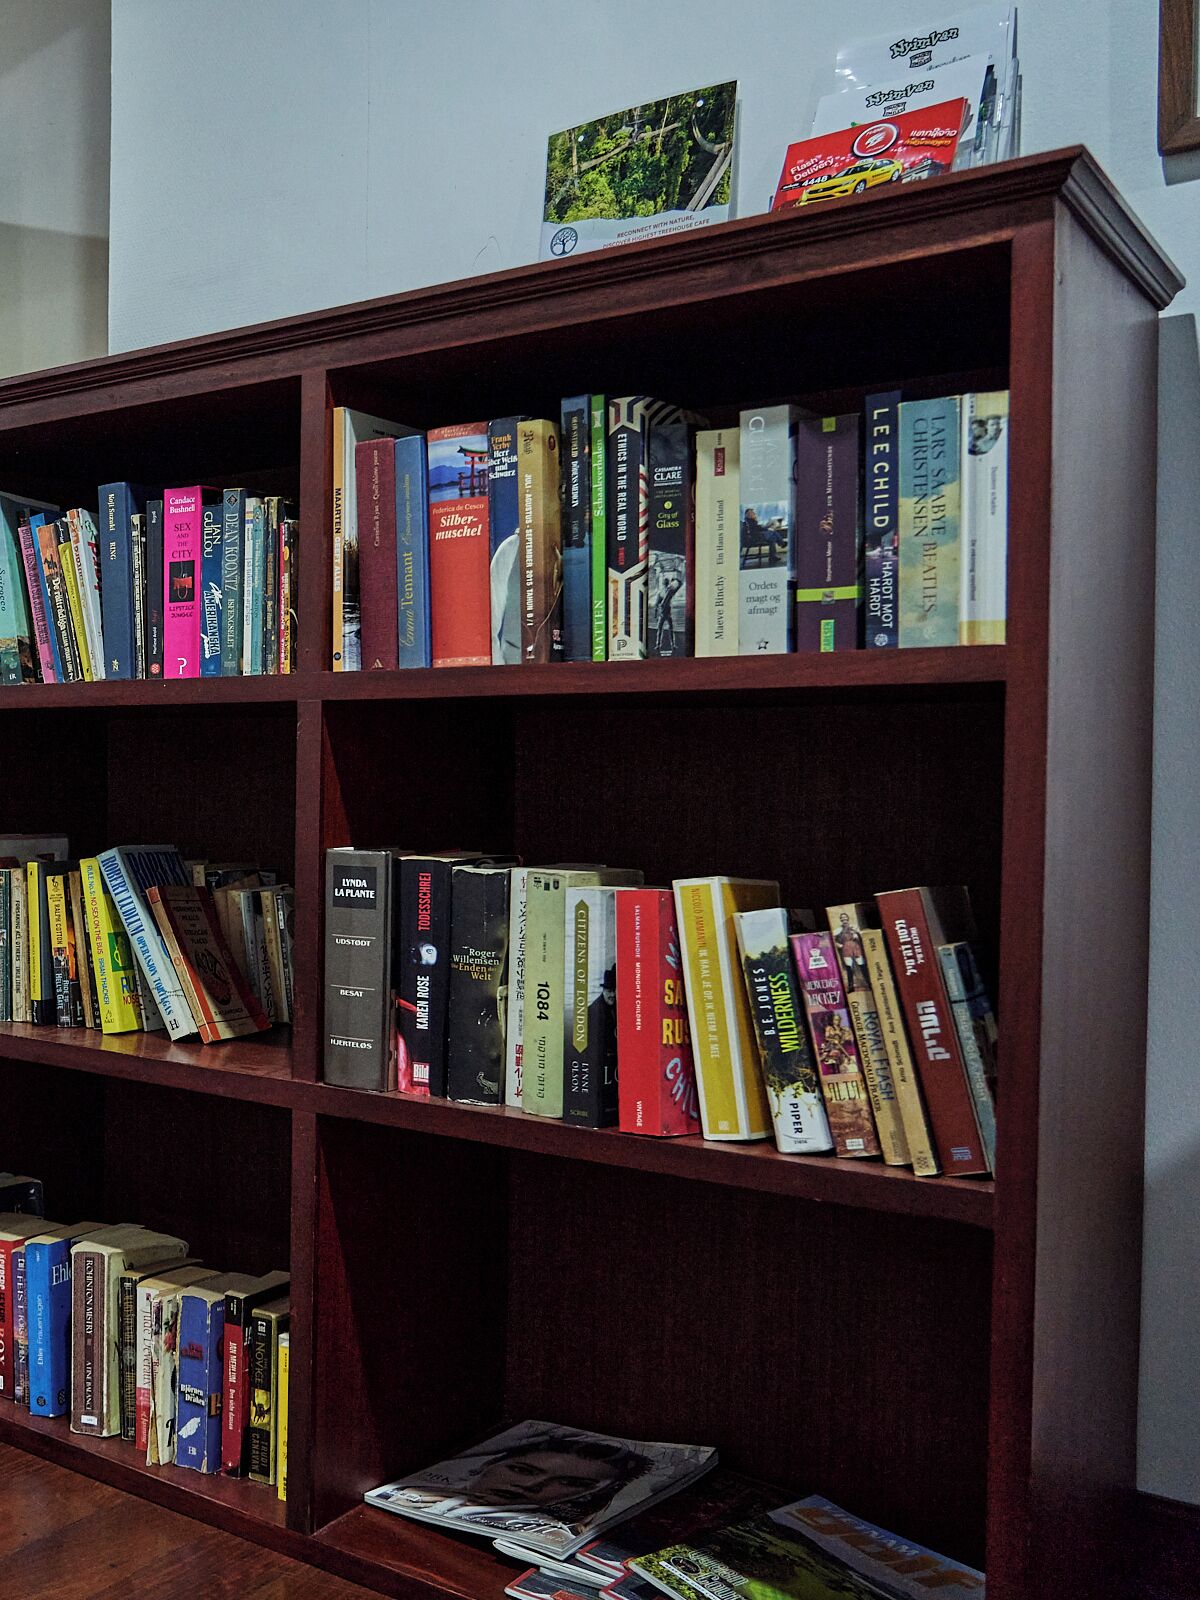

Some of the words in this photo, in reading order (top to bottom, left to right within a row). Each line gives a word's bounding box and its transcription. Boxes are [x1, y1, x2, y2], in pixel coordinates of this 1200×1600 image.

[790, 157, 819, 175] Flash
[793, 158, 835, 182] Delivery
[801, 175, 828, 187] 4448
[617, 225, 652, 238] RECONNECT
[653, 220, 669, 231] WITH
[669, 214, 695, 226] NATURE,
[658, 222, 693, 236] TREEHOUSE
[491, 434, 512, 444] Frank
[873, 408, 889, 454] LEE
[930, 415, 946, 459] LARS
[493, 450, 509, 458] Herr
[616, 433, 627, 461] ETHICS
[488, 469, 516, 480] Schwarz
[593, 438, 603, 517] Schaakverhalen
[616, 463, 627, 472] IN
[654, 471, 682, 481] CLARE
[525, 473, 533, 488] JULI
[616, 474, 627, 490] THE
[912, 418, 928, 538] CHRISTENSEN
[108, 493, 116, 507] Koji
[169, 495, 196, 506] Candace
[616, 491, 627, 511] REAL
[873, 462, 889, 528] CHILD
[930, 465, 946, 537] SAABYE
[169, 504, 196, 515] Bushnell
[432, 504, 455, 515] Federica
[464, 503, 484, 511] Cesco
[525, 493, 533, 524] AGUSTUS
[716, 499, 724, 522] Irland
[108, 508, 116, 532] Suzuki
[173, 522, 192, 532] SEX
[225, 513, 238, 543] DEAN
[440, 514, 478, 528] Silber-
[616, 513, 627, 541] WORLD
[656, 519, 680, 529] Glass
[203, 511, 214, 559] GUILLOU
[212, 523, 222, 545] JAN
[435, 524, 483, 541] muschel
[716, 532, 724, 550] Haus
[108, 541, 116, 561] RING
[172, 549, 193, 559] CITY
[526, 528, 534, 567] SEPTEMBER
[225, 546, 238, 591] KOONTZ
[716, 553, 724, 565] Ein
[50, 577, 62, 591] De
[399, 551, 413, 608] Tennant
[748, 581, 778, 591] Ordets
[882, 561, 893, 599] HARDT
[921, 541, 938, 614] BEATLES
[526, 588, 534, 610] TAHUN
[713, 574, 725, 607] Binchy
[746, 595, 768, 604] magt
[769, 594, 781, 603] og
[869, 578, 881, 617] HARDT
[169, 604, 195, 614] LIPSTICK
[171, 611, 194, 619] JUNGLE
[748, 606, 778, 616] afmagt
[883, 602, 893, 629] MOT
[203, 591, 220, 656] AMERIKANSKA
[593, 599, 603, 656] MATTEN
[714, 608, 725, 639] Maeve
[334, 888, 344, 897] LA
[345, 888, 376, 899] PLANTE
[342, 878, 368, 889] LYNDA
[90, 896, 97, 906] NO
[418, 872, 431, 931] TODESSCHREI
[91, 906, 99, 919] SEX
[101, 855, 130, 898] ROBERT
[117, 892, 145, 936] LUDLUM
[136, 935, 159, 977] OPERASJON
[92, 919, 100, 929] ON
[335, 938, 371, 947] UDSTØDT
[577, 909, 586, 963] CITIZENS
[95, 941, 103, 954] BUS
[469, 948, 496, 959] Roger
[698, 948, 708, 957] IK
[97, 957, 106, 976] BRIAN
[452, 954, 500, 965] Willemsen
[459, 962, 487, 972] Enden
[699, 958, 710, 978] HAAL
[416, 974, 429, 998] ROSE
[471, 971, 492, 981] Welt
[576, 968, 586, 984] OF
[701, 979, 711, 989] JE
[100, 976, 110, 1004] THACKER
[340, 989, 364, 998] BESAT
[752, 967, 771, 1010] JONES
[536, 981, 550, 1021] 1Q84
[704, 1002, 713, 1010] IK
[416, 1000, 429, 1029] KAREN
[575, 989, 585, 1042] LONDON
[705, 1011, 716, 1032] NEEM
[762, 1013, 773, 1024] E.
[771, 972, 799, 1054] WILDERNESS
[707, 1032, 717, 1041] JE
[764, 1024, 775, 1036] B.
[862, 1009, 886, 1055] ROYAL
[330, 1038, 373, 1050] HJERTELØS
[708, 1042, 719, 1058] MEE
[850, 1000, 864, 1033] GEORGE
[857, 1032, 875, 1083] MACDONALD
[869, 1083, 882, 1112] FRASER
[571, 1060, 579, 1093] OLSON
[581, 1062, 589, 1094] LYNNE
[872, 1056, 896, 1102] FLASH
[790, 1102, 803, 1135] PIPER
[84, 1259, 93, 1305] ROHINTON
[84, 1306, 93, 1334] MISTRY
[253, 1340, 265, 1384] NOVICE
[250, 1432, 259, 1470] CANAVAN
[259, 1440, 267, 1467] TRUDI
